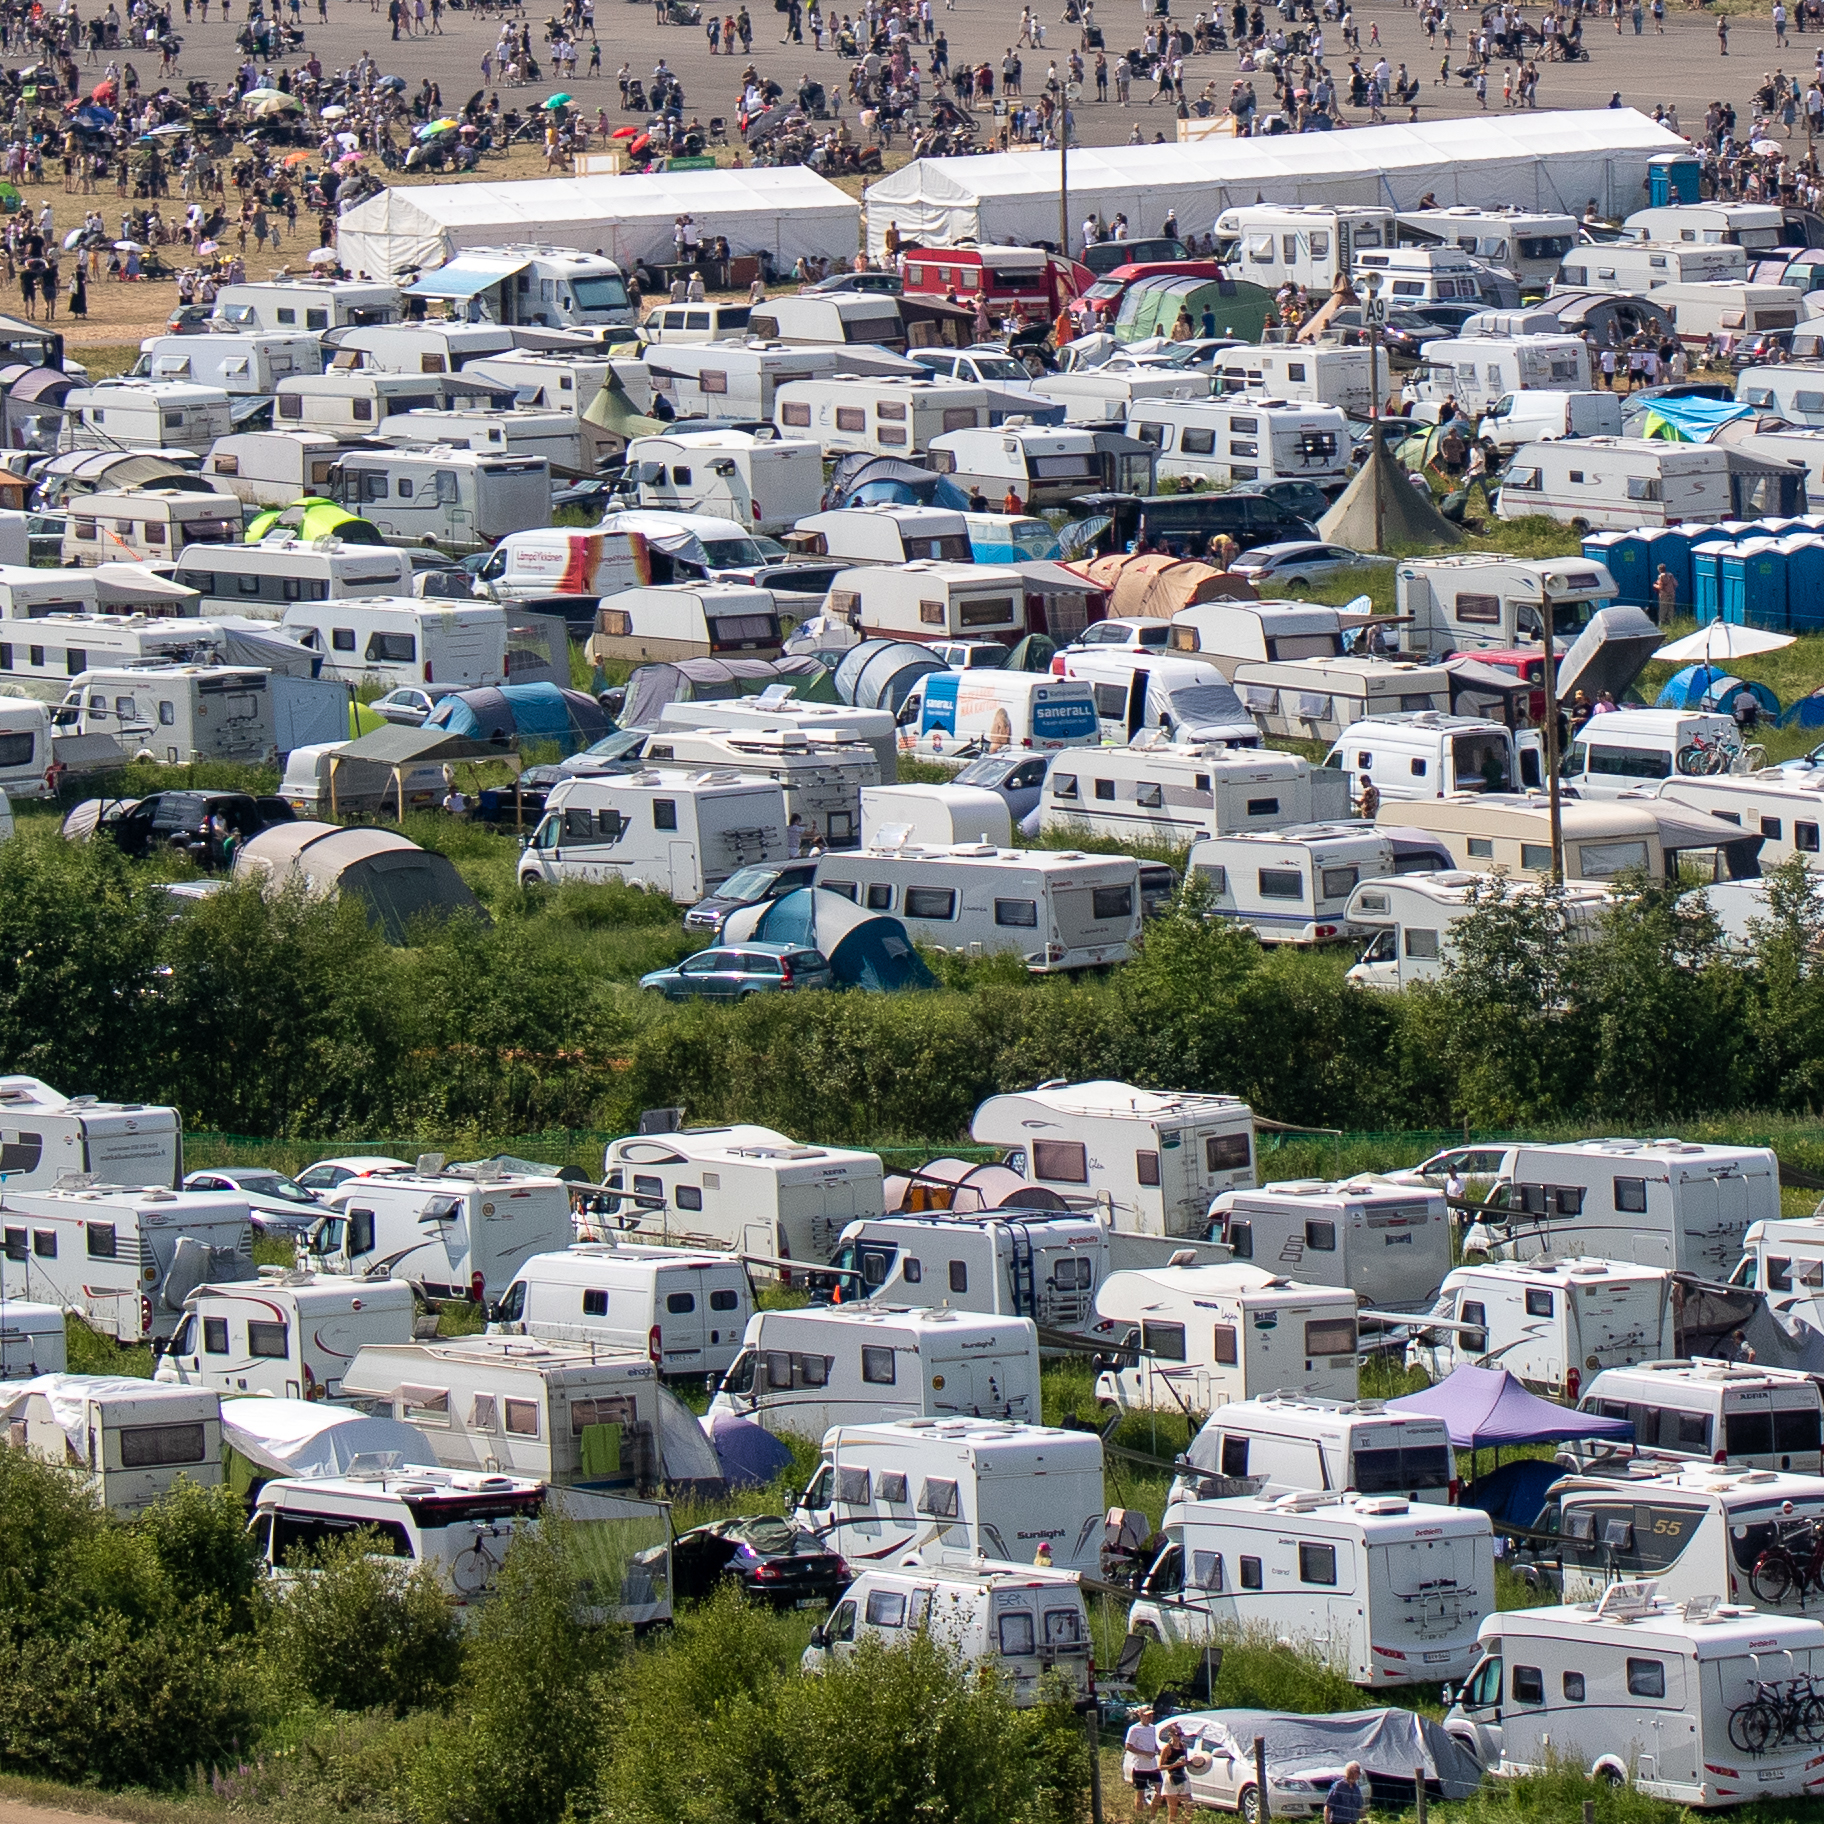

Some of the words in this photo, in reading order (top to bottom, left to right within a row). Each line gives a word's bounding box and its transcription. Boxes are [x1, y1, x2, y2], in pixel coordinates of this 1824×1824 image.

[1365, 299, 1384, 322] A9
[1017, 1528, 1066, 1540] Sunlight
[1653, 1519, 1683, 1536] 55
